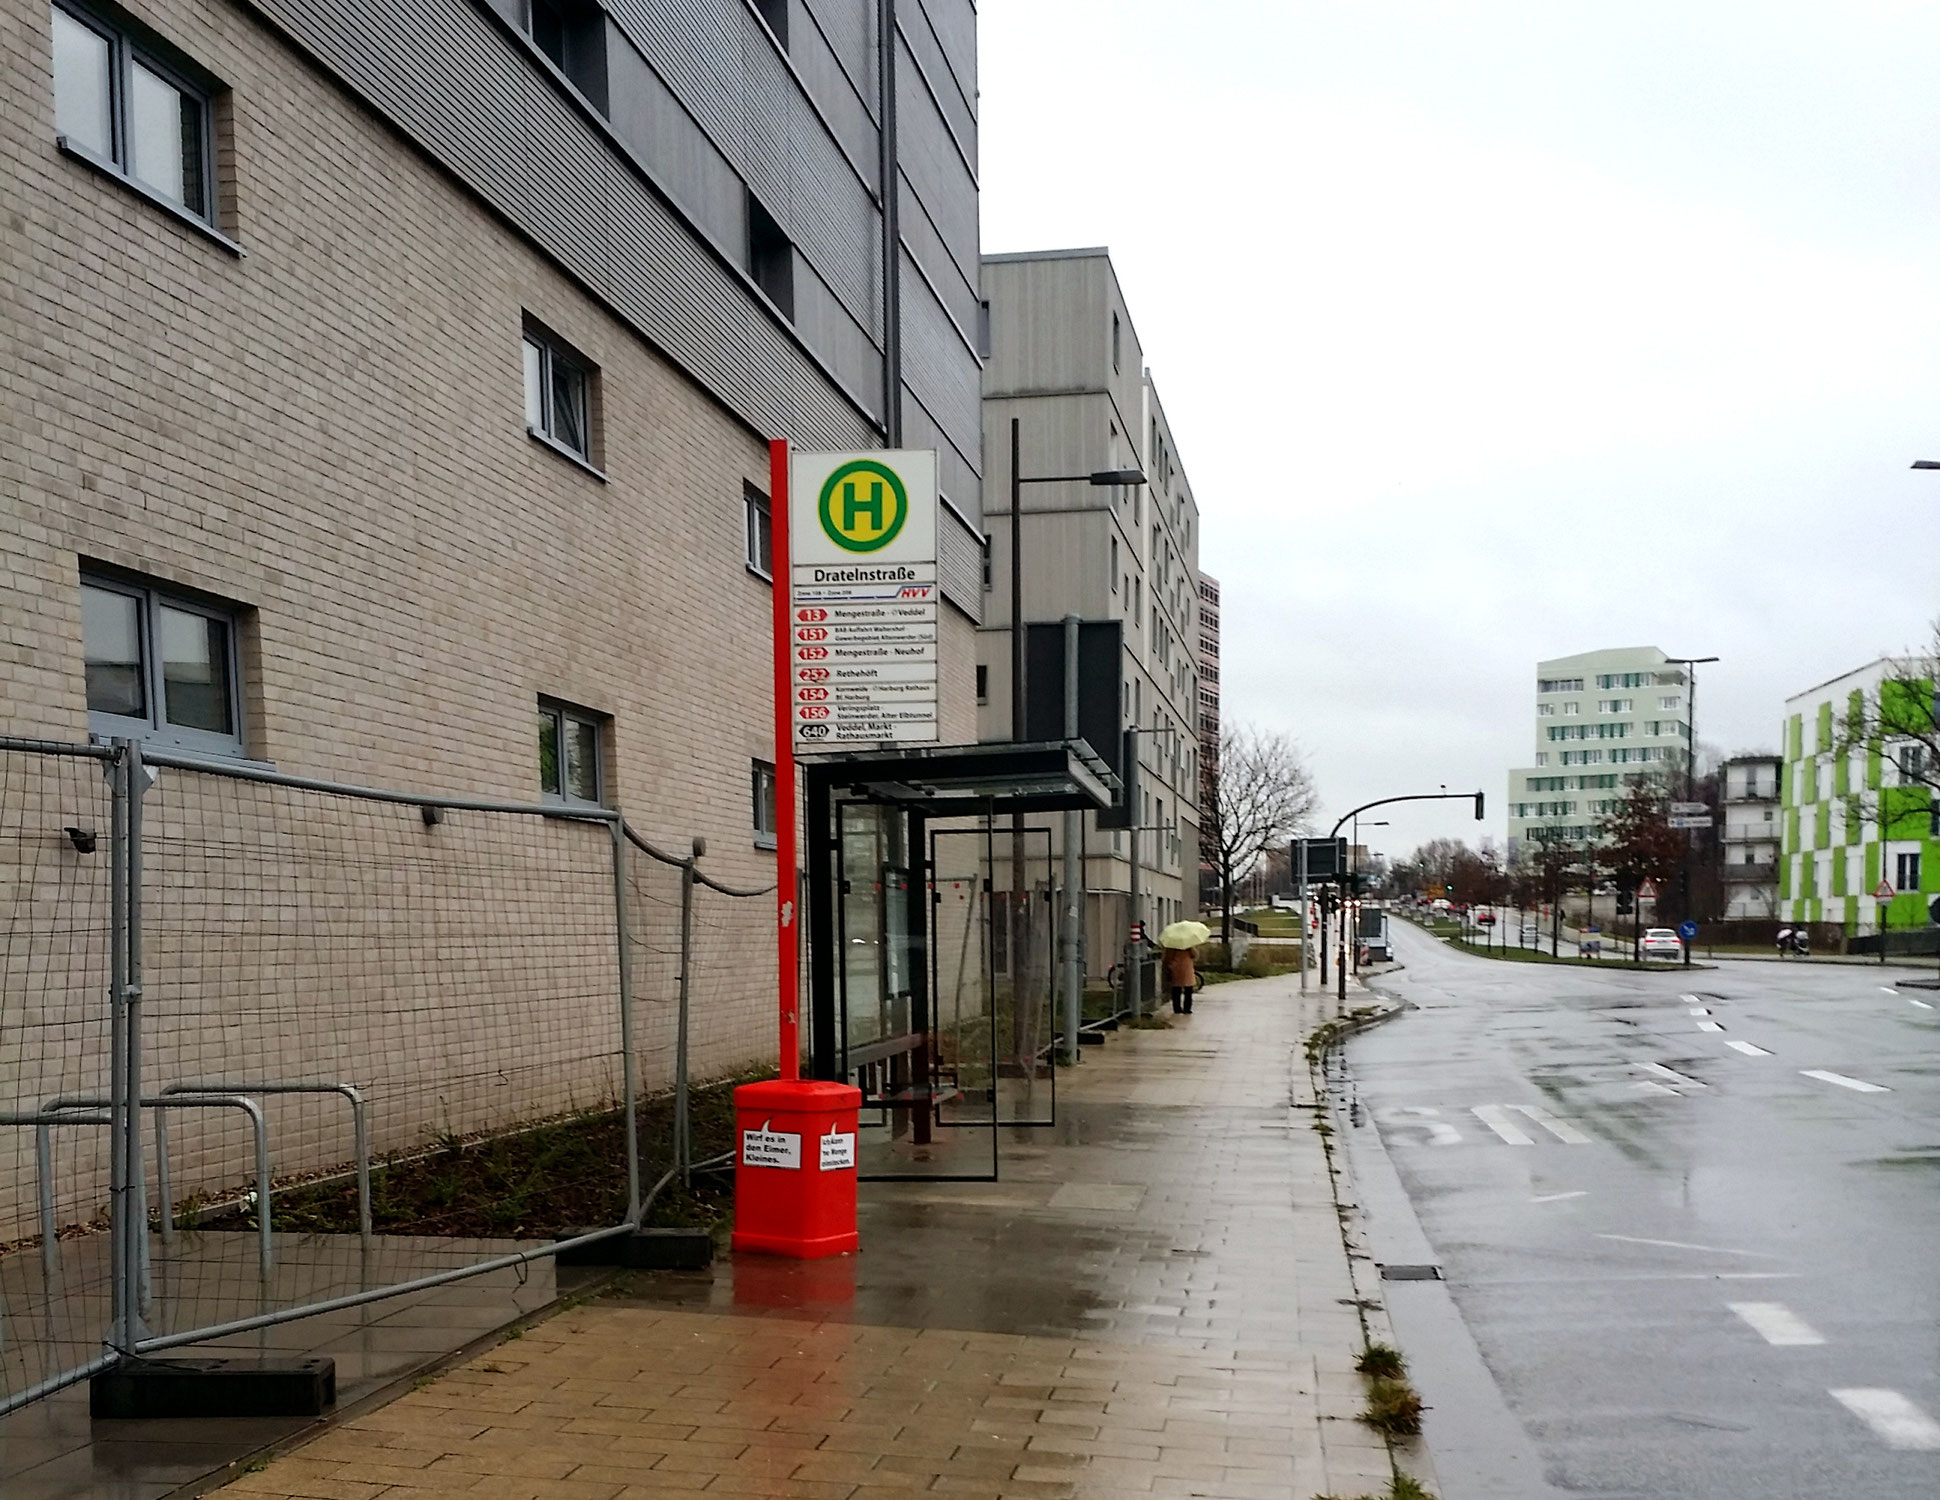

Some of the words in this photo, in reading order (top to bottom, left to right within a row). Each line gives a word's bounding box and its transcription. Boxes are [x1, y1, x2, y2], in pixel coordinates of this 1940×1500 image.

[843, 482, 883, 531] H
[814, 566, 915, 582] Dratelnstraße
[901, 588, 930, 598] HVV
[806, 610, 821, 621] 13
[834, 609, 885, 619] Mengestraße
[898, 608, 926, 616] Veddel
[803, 629, 824, 640] 151
[803, 648, 824, 659] 152
[835, 648, 888, 658] Mengestraße
[894, 647, 925, 656] Neuhof
[803, 669, 826, 680] 252
[836, 669, 878, 678] Rethehöft
[803, 689, 825, 700] 154
[803, 708, 826, 719] 156
[803, 726, 826, 737] 640
[836, 723, 865, 731] Veddel,
[868, 722, 892, 730] Markt
[836, 731, 893, 740] Rathausmarkt
[746, 1133, 763, 1142] Wirf
[763, 1145, 791, 1155] Eimer,
[746, 1154, 780, 1164] Kleines.
